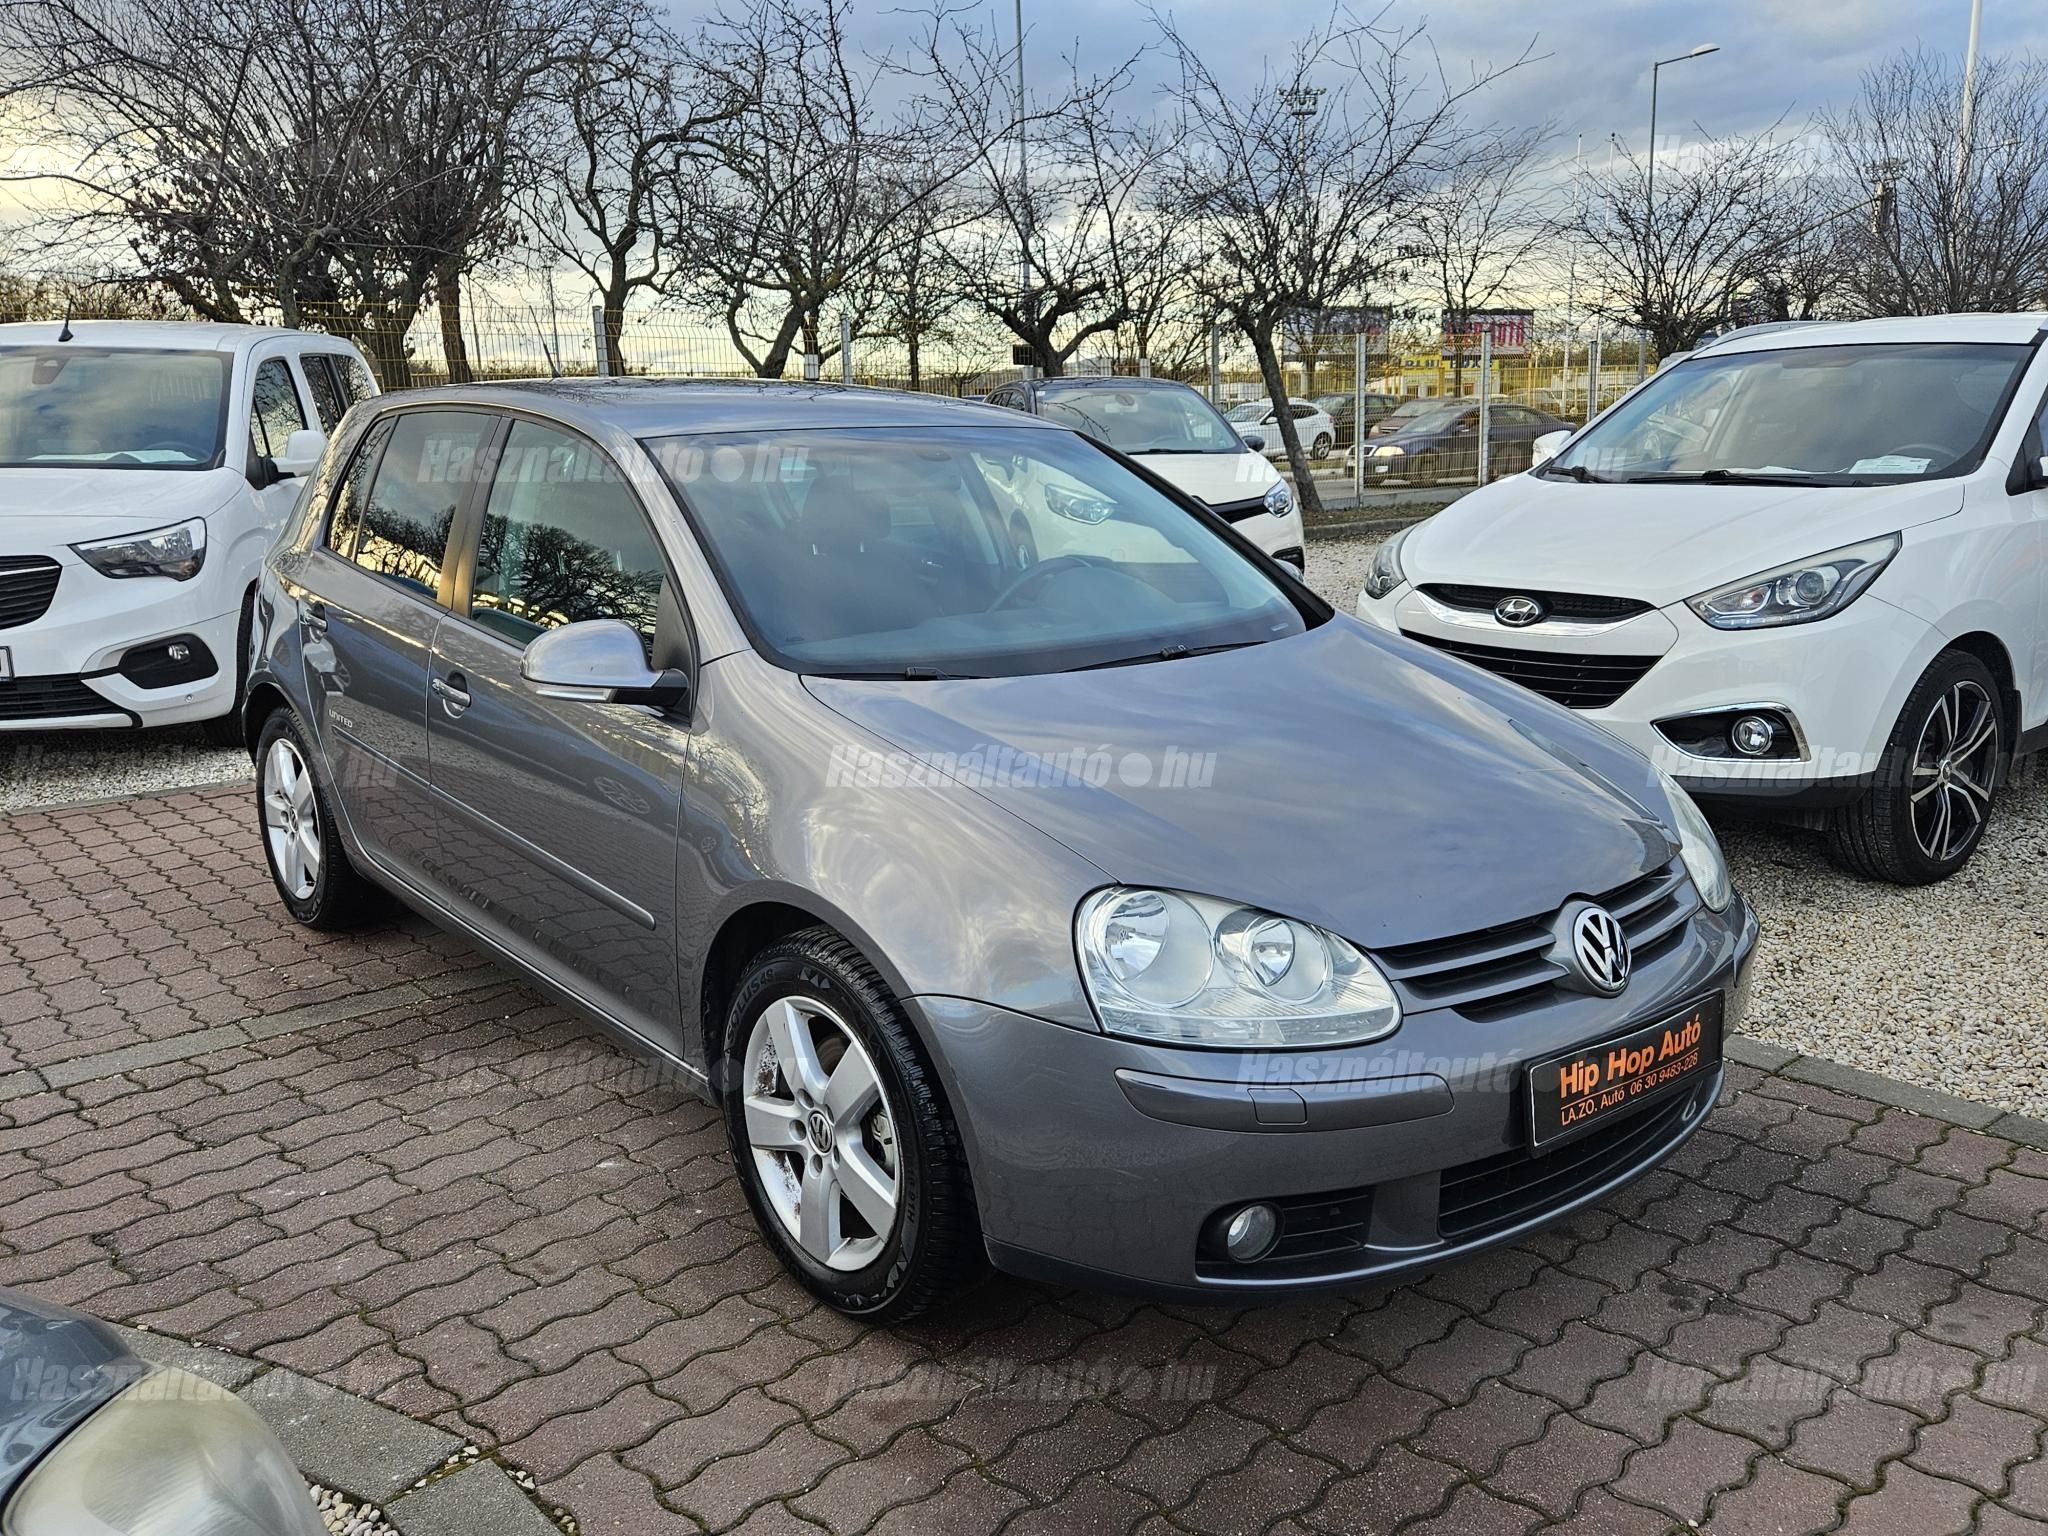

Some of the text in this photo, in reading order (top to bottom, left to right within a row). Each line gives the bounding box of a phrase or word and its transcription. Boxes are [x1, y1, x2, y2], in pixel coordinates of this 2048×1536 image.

[329, 709, 352, 727] UNITED
[1560, 1013, 1702, 1098] Hip Hop Autó
[1561, 1099, 1598, 1126] LA.ZO.
[1600, 1087, 1625, 1110] Autó
[1630, 1079, 1643, 1095] 06
[1645, 1074, 1657, 1089] 30
